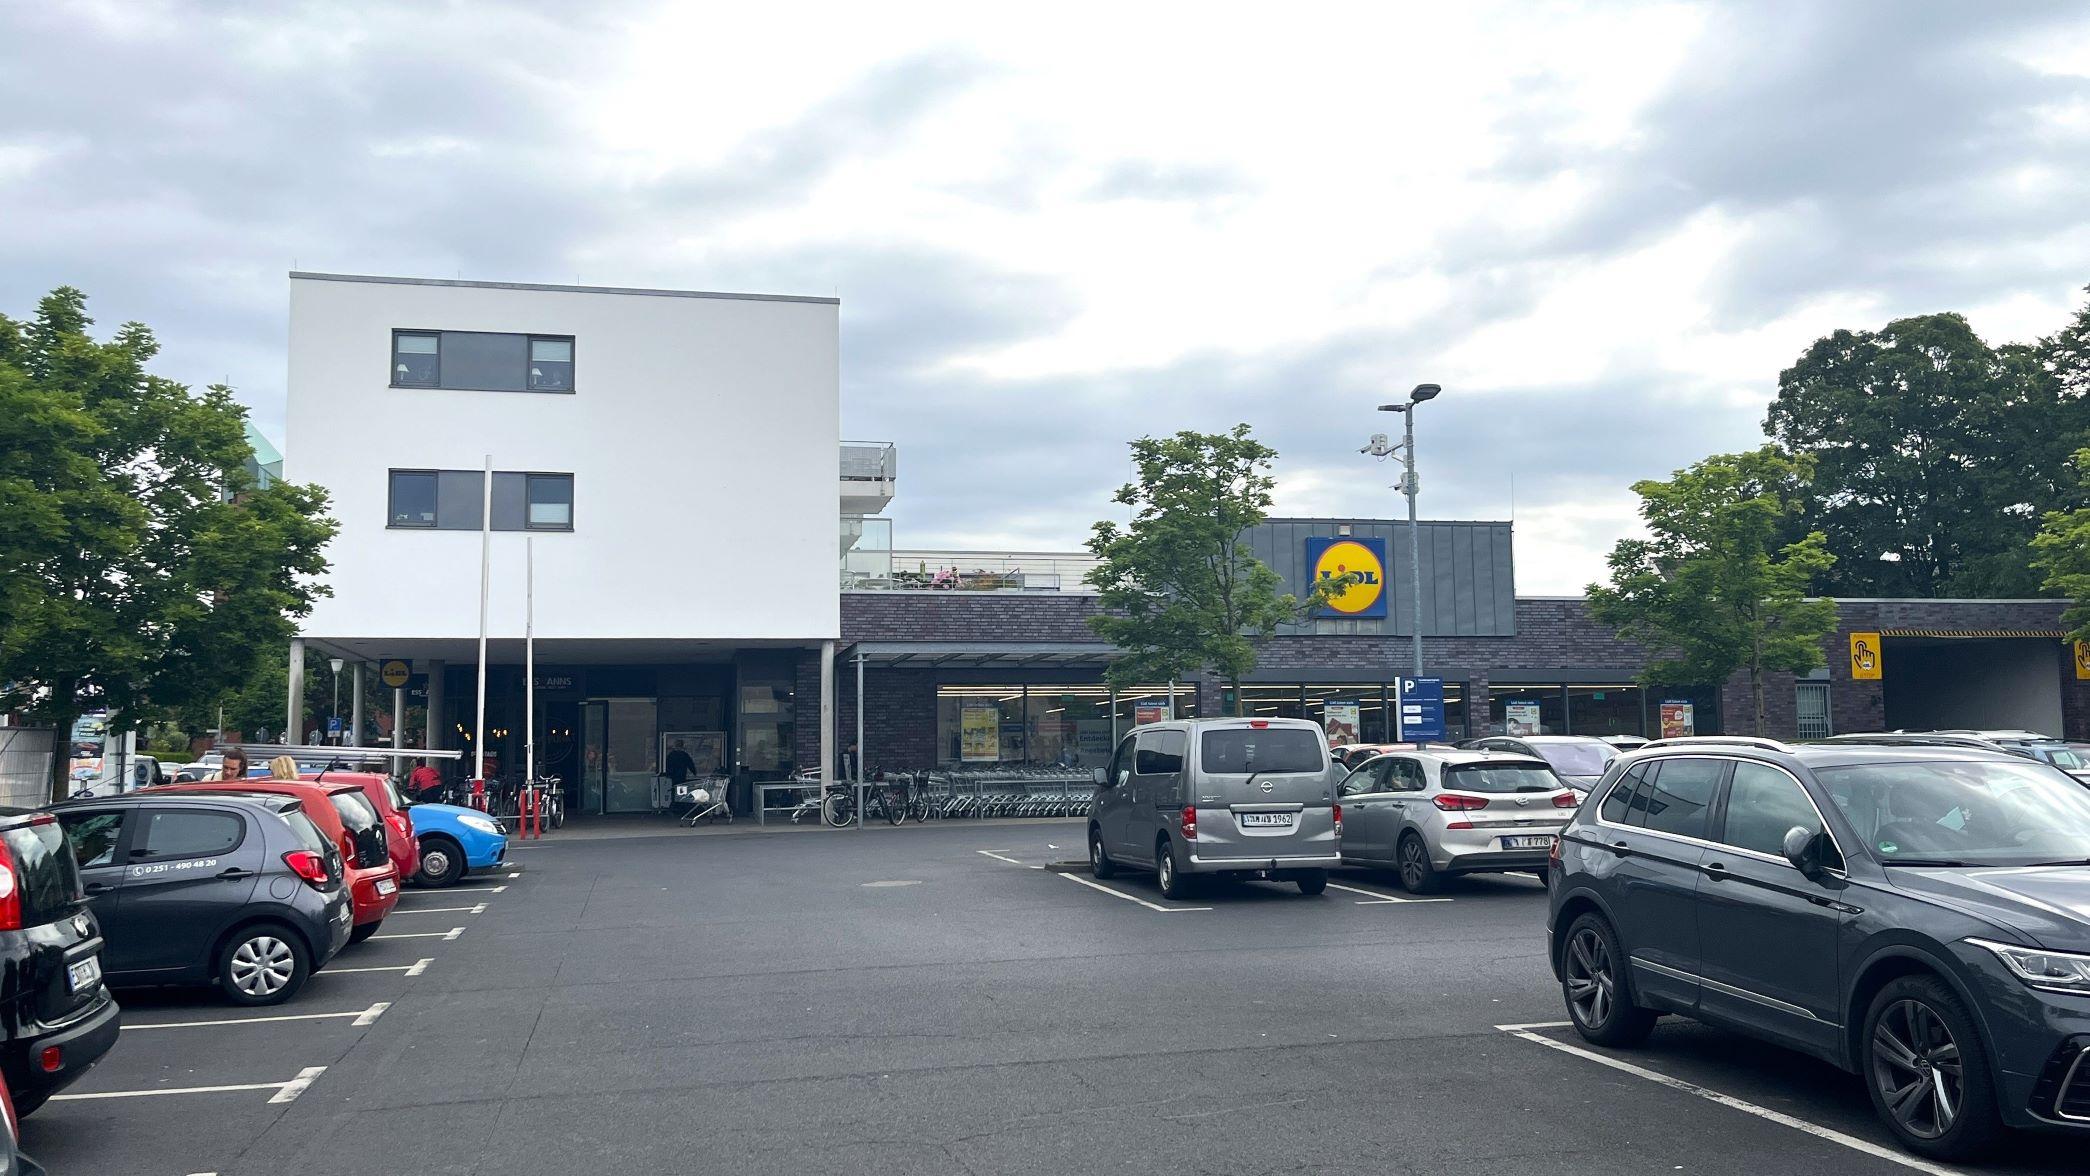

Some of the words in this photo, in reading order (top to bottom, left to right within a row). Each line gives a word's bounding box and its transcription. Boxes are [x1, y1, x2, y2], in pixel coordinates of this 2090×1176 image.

[1404, 680, 1415, 693] P
[330, 719, 337, 730] P
[1273, 815, 1291, 823] 1962
[152, 864, 168, 872] 251
[175, 862, 192, 870] 490
[193, 860, 204, 868] 48
